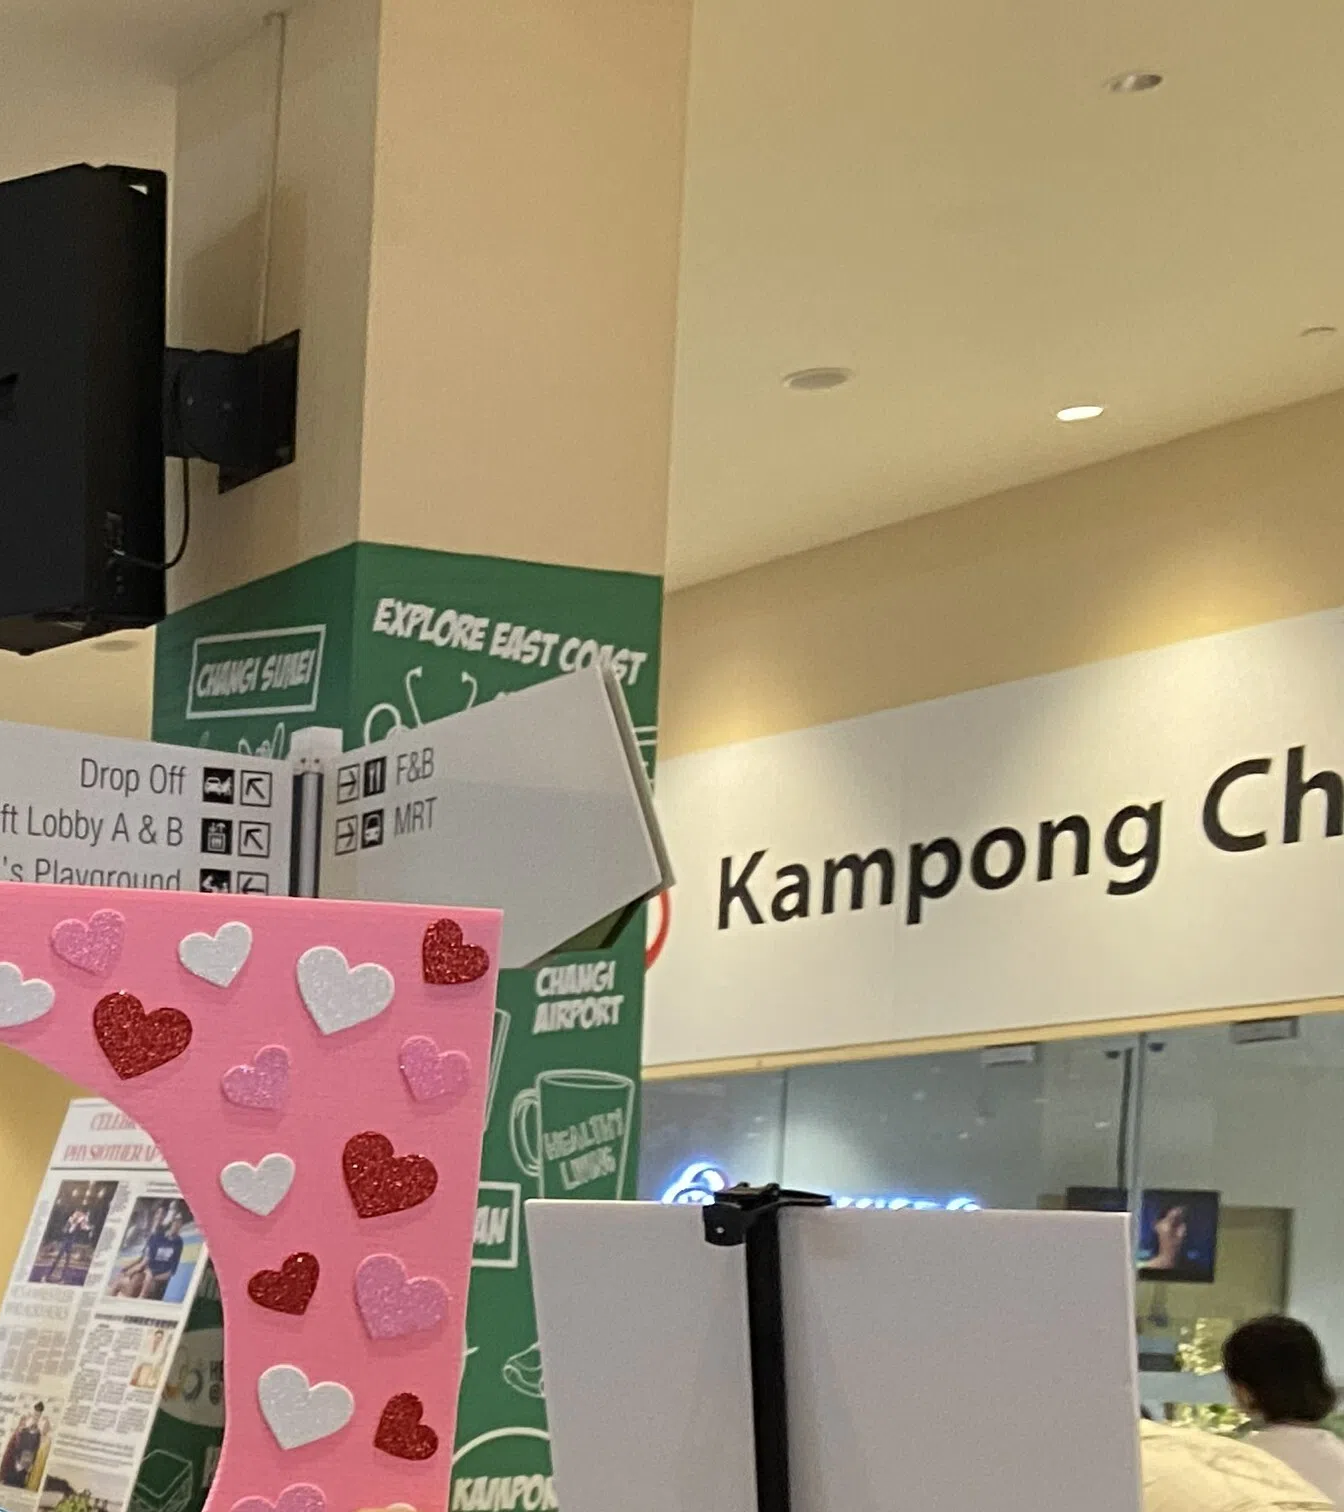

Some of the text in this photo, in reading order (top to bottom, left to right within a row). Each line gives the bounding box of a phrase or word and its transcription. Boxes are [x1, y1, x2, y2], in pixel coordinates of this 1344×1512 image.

[372, 598, 490, 652] EXPLORE
[488, 622, 560, 667] EAST
[196, 656, 262, 698] CHANGI
[79, 757, 188, 797] Drop Off
[396, 747, 434, 786] F&B
[27, 804, 104, 848] Lobby
[111, 812, 130, 843] A
[137, 814, 158, 845] &
[166, 816, 184, 847] B
[394, 796, 438, 837] MRT
[716, 798, 1164, 931] Kampong
[535, 960, 617, 997] CHANGI
[532, 995, 625, 1035] AIRPORT
